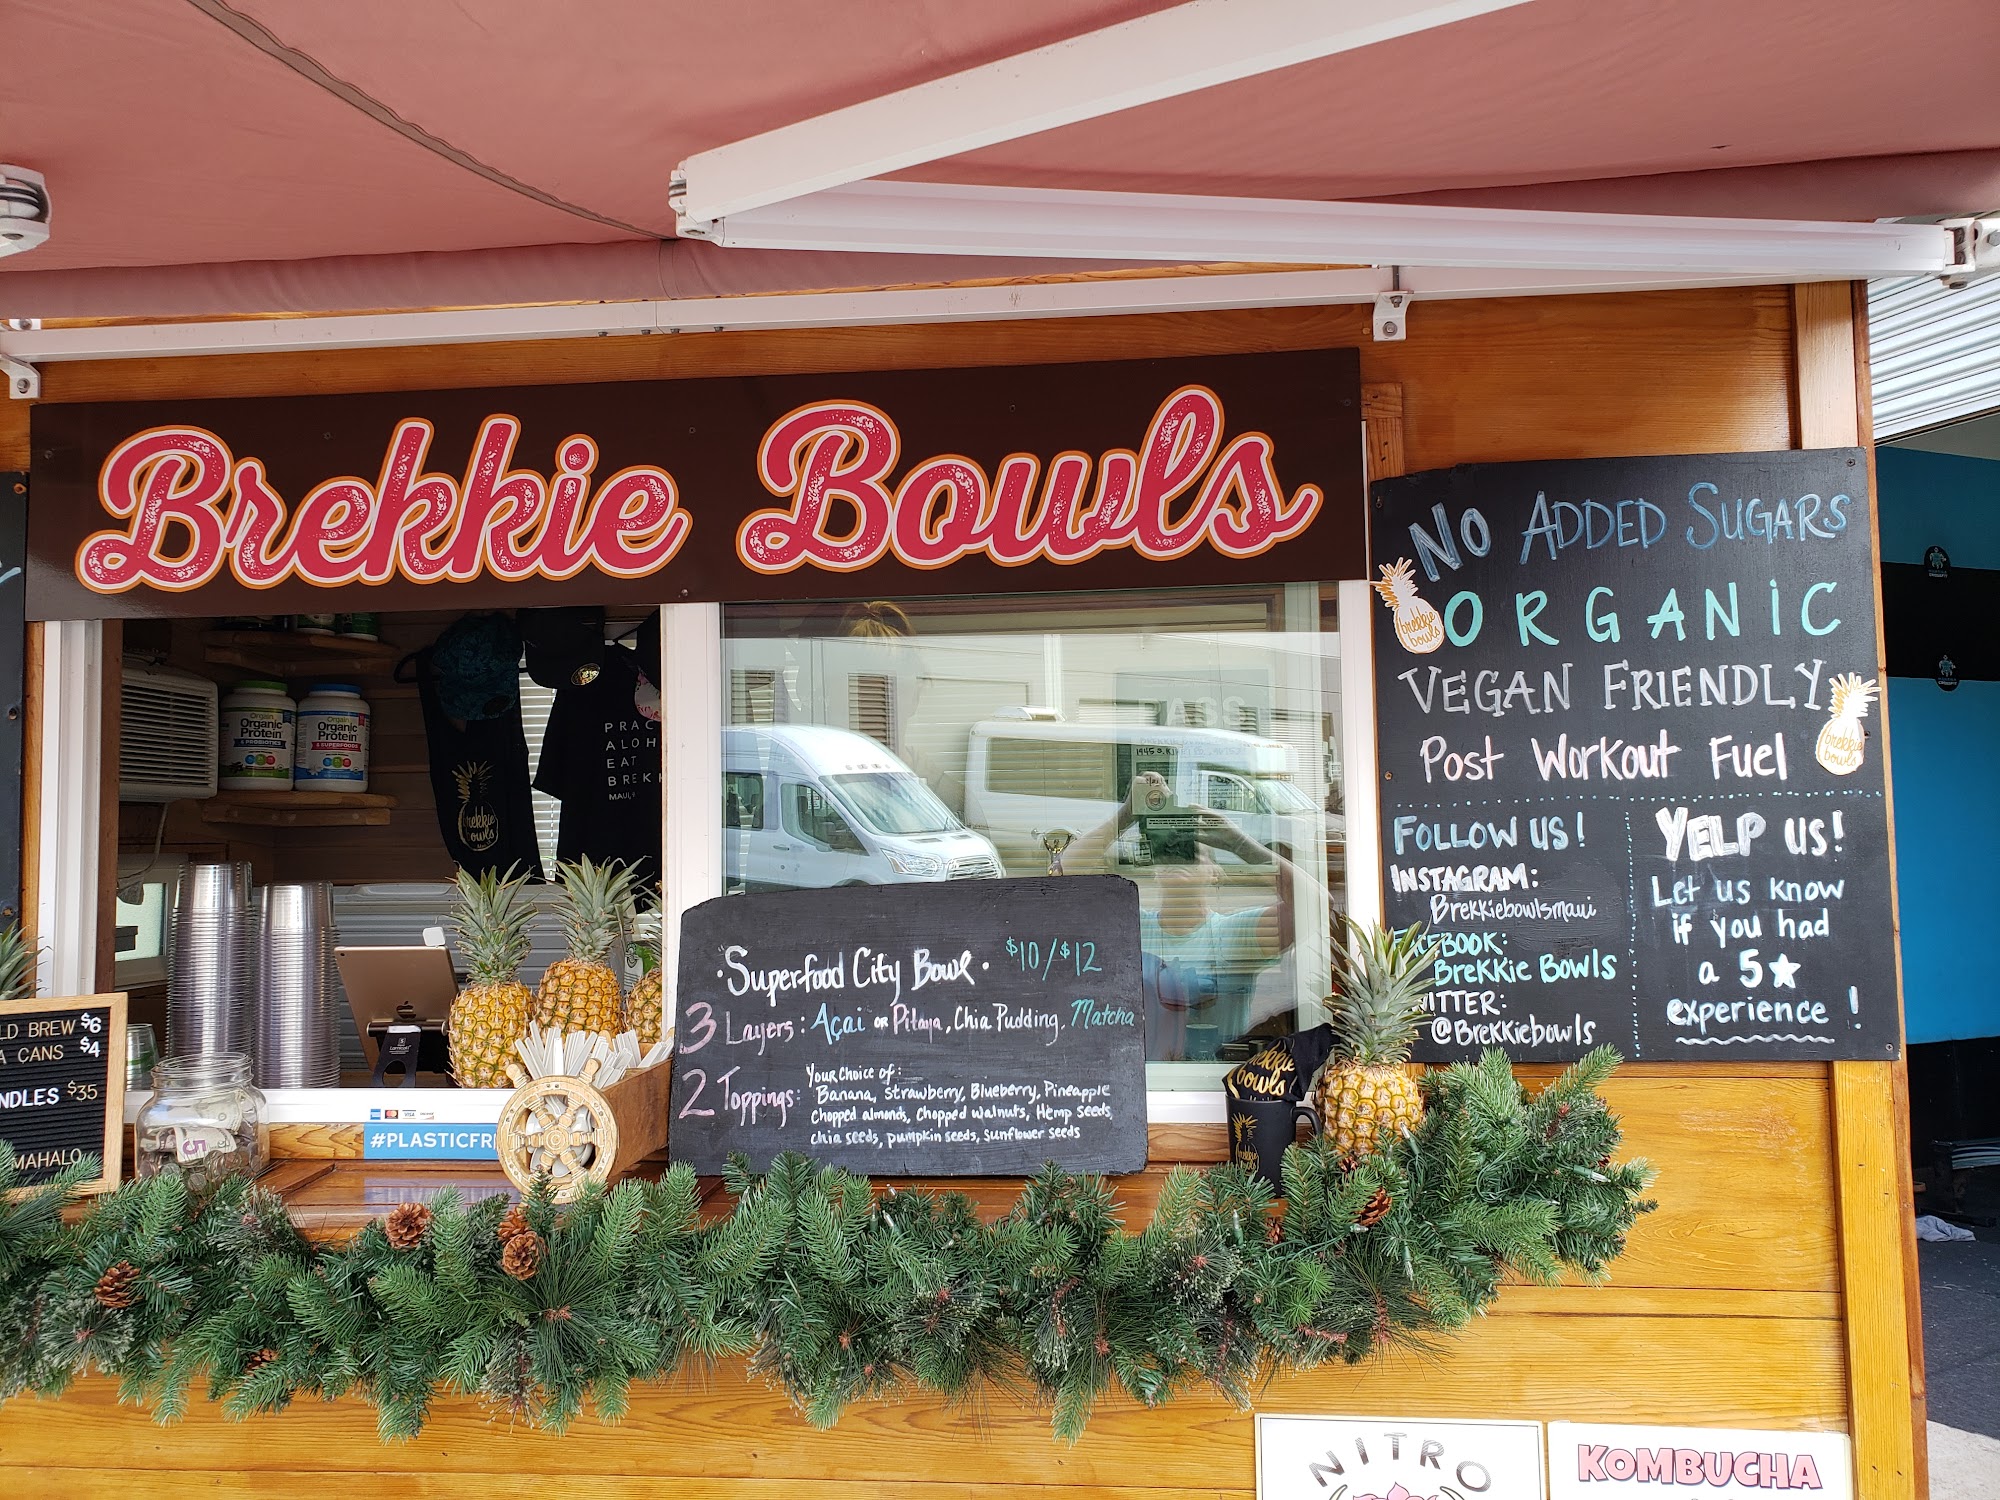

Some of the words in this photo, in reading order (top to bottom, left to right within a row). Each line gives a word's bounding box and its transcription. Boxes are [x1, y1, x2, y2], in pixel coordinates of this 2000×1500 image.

[75, 413, 693, 594] Brekkie
[736, 384, 1323, 575] Bowls
[1398, 662, 1573, 717] VEGAN
[1604, 659, 1828, 712] FRIENDLY
[240, 718, 282, 729] Organic
[240, 728, 282, 738] Protein
[317, 721, 358, 733] Organic
[318, 731, 358, 742] Protein
[604, 720, 654, 733] PRAC
[605, 738, 656, 751] ALOH
[1420, 734, 1505, 783] Post
[1710, 731, 1788, 781] Fuel
[607, 756, 637, 769] EAT
[1655, 806, 1767, 862] YELP
[1390, 863, 1538, 894] INSTAGRAM:
[1651, 874, 1701, 908] Let
[1716, 880, 1751, 905] us
[1769, 876, 1846, 904] know
[1710, 916, 1762, 949] you
[1777, 908, 1831, 938] had
[725, 945, 845, 1007] Superfood
[853, 947, 900, 1006] City
[911, 949, 975, 991] Bowl
[1540, 950, 1618, 984] Bowls
[1699, 961, 1721, 986] a
[1737, 948, 1764, 988] 5
[29, 1019, 76, 1038] BREW
[81, 1012, 102, 1034] $6
[679, 1001, 718, 1054] 3
[954, 1005, 993, 1030] Chia
[1071, 999, 1135, 1030] Matcha
[1666, 997, 1830, 1037] experience
[18, 1045, 64, 1064] CANS
[80, 1036, 101, 1058] $4
[67, 1080, 98, 1102] $35
[679, 1069, 716, 1119] 2
[816, 1085, 877, 1104] Banana,
[970, 1083, 1041, 1104] Blueberry,
[1044, 1080, 1111, 1102] Pineapple
[862, 1106, 911, 1124] almonds,
[1036, 1103, 1073, 1124] Hemp
[370, 1132, 496, 1149] #PLASTICFR
[846, 1130, 883, 1148] seeds,
[887, 1128, 942, 1148] pumpkin
[945, 1128, 980, 1143] seeds,
[1048, 1125, 1081, 1139] seeds
[12, 1148, 82, 1171] MAHALO
[1309, 1432, 1491, 1492] NITRO
[1578, 1444, 1823, 1489] KOMBUCHA
